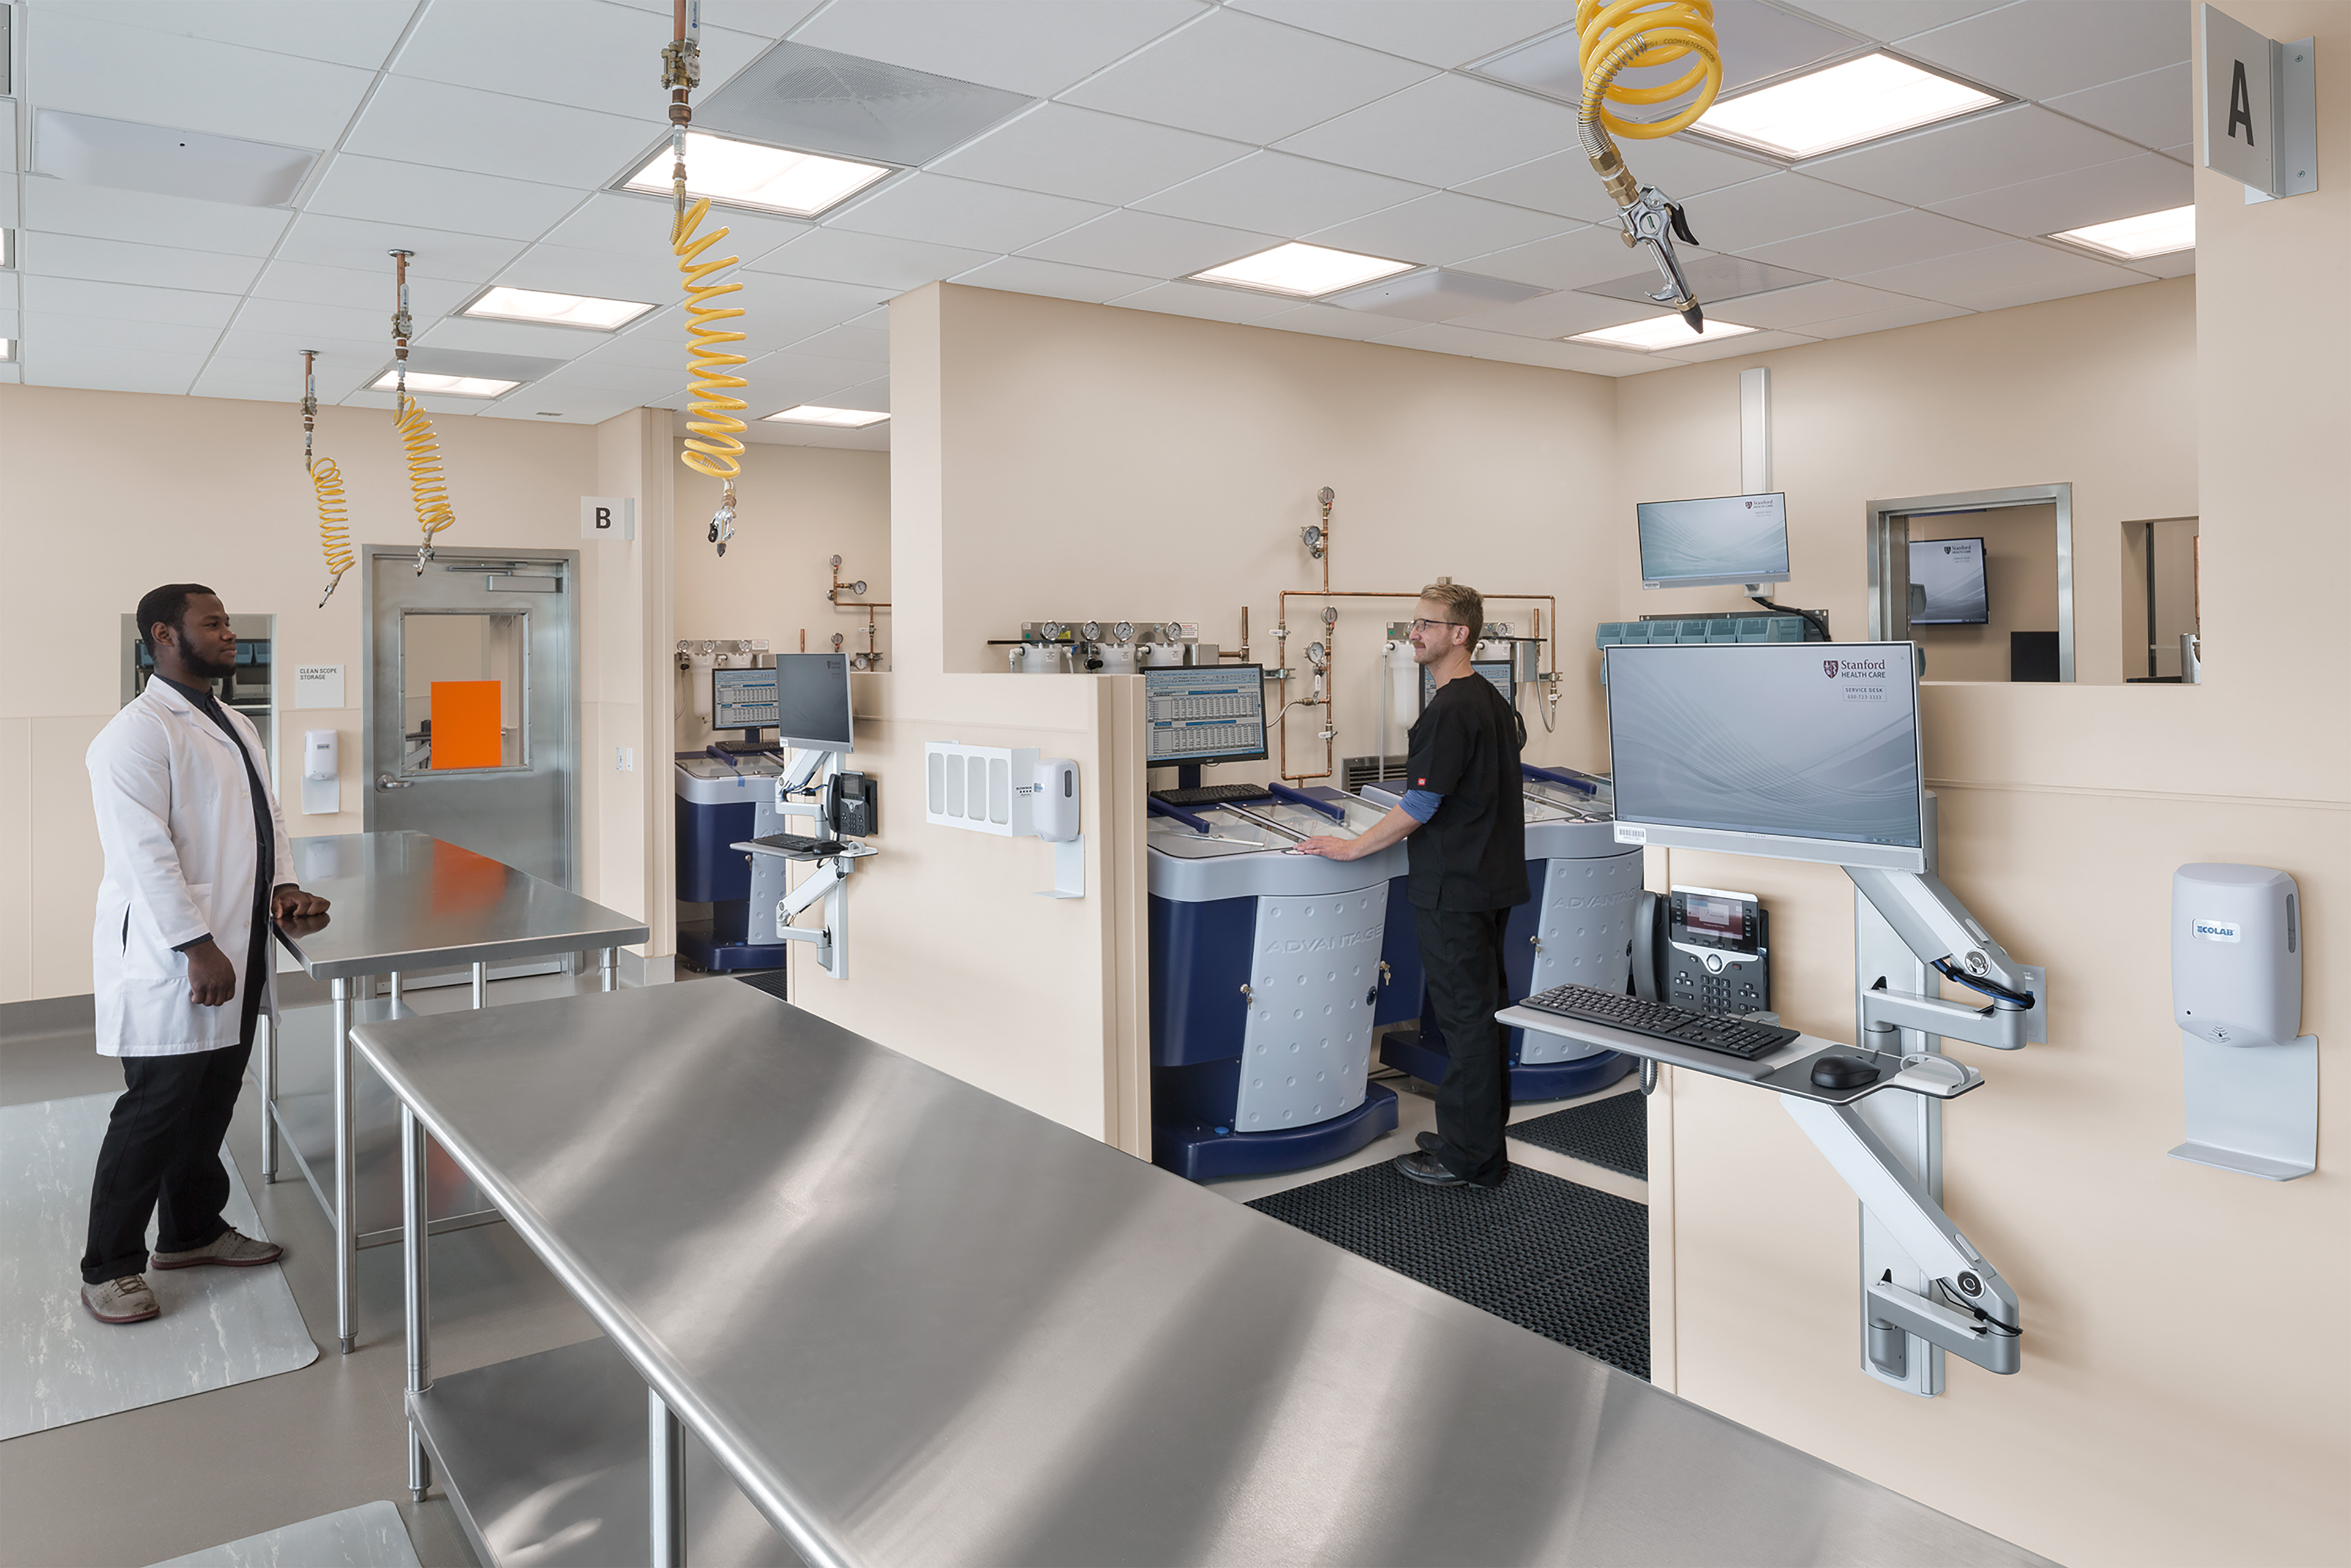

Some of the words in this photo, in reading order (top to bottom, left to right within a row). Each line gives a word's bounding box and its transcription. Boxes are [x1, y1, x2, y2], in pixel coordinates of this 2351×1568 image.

[2227, 59, 2255, 148] A
[596, 507, 611, 529] B
[1840, 659, 1885, 670] Stanford
[1265, 923, 1383, 954] ADVANTAGE
[2197, 926, 2233, 936] ECOLAB
